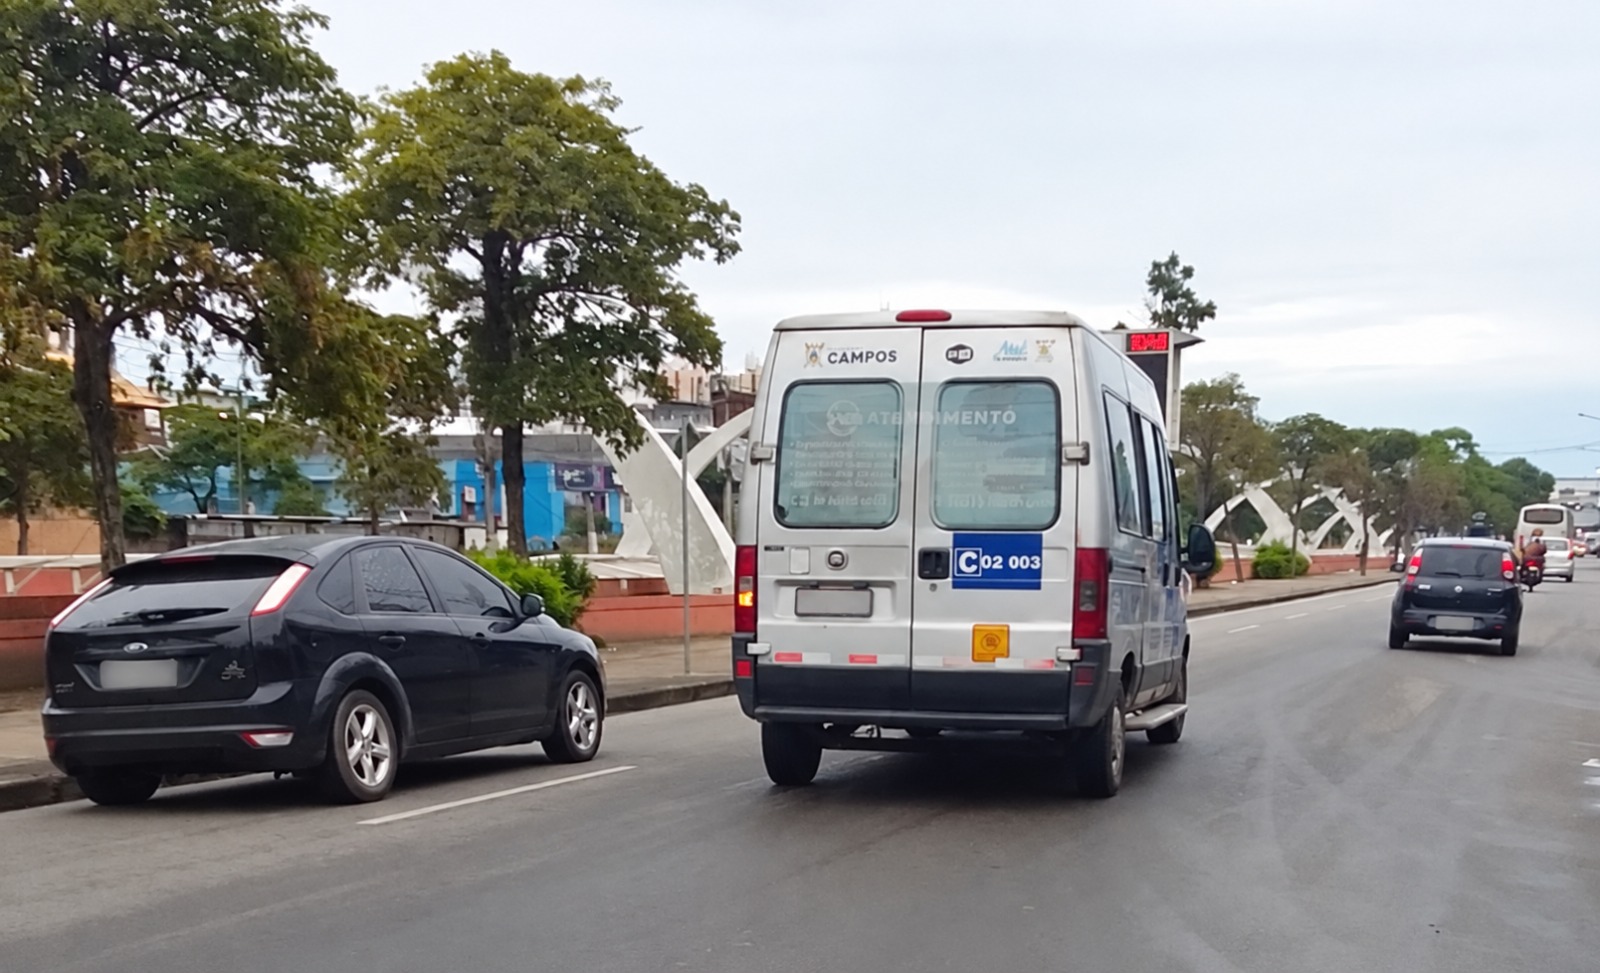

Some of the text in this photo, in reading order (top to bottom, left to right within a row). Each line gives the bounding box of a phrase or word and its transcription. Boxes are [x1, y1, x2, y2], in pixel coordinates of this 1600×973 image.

[827, 350, 898, 365] CAMPOS
[958, 550, 1042, 573] C 02 003
